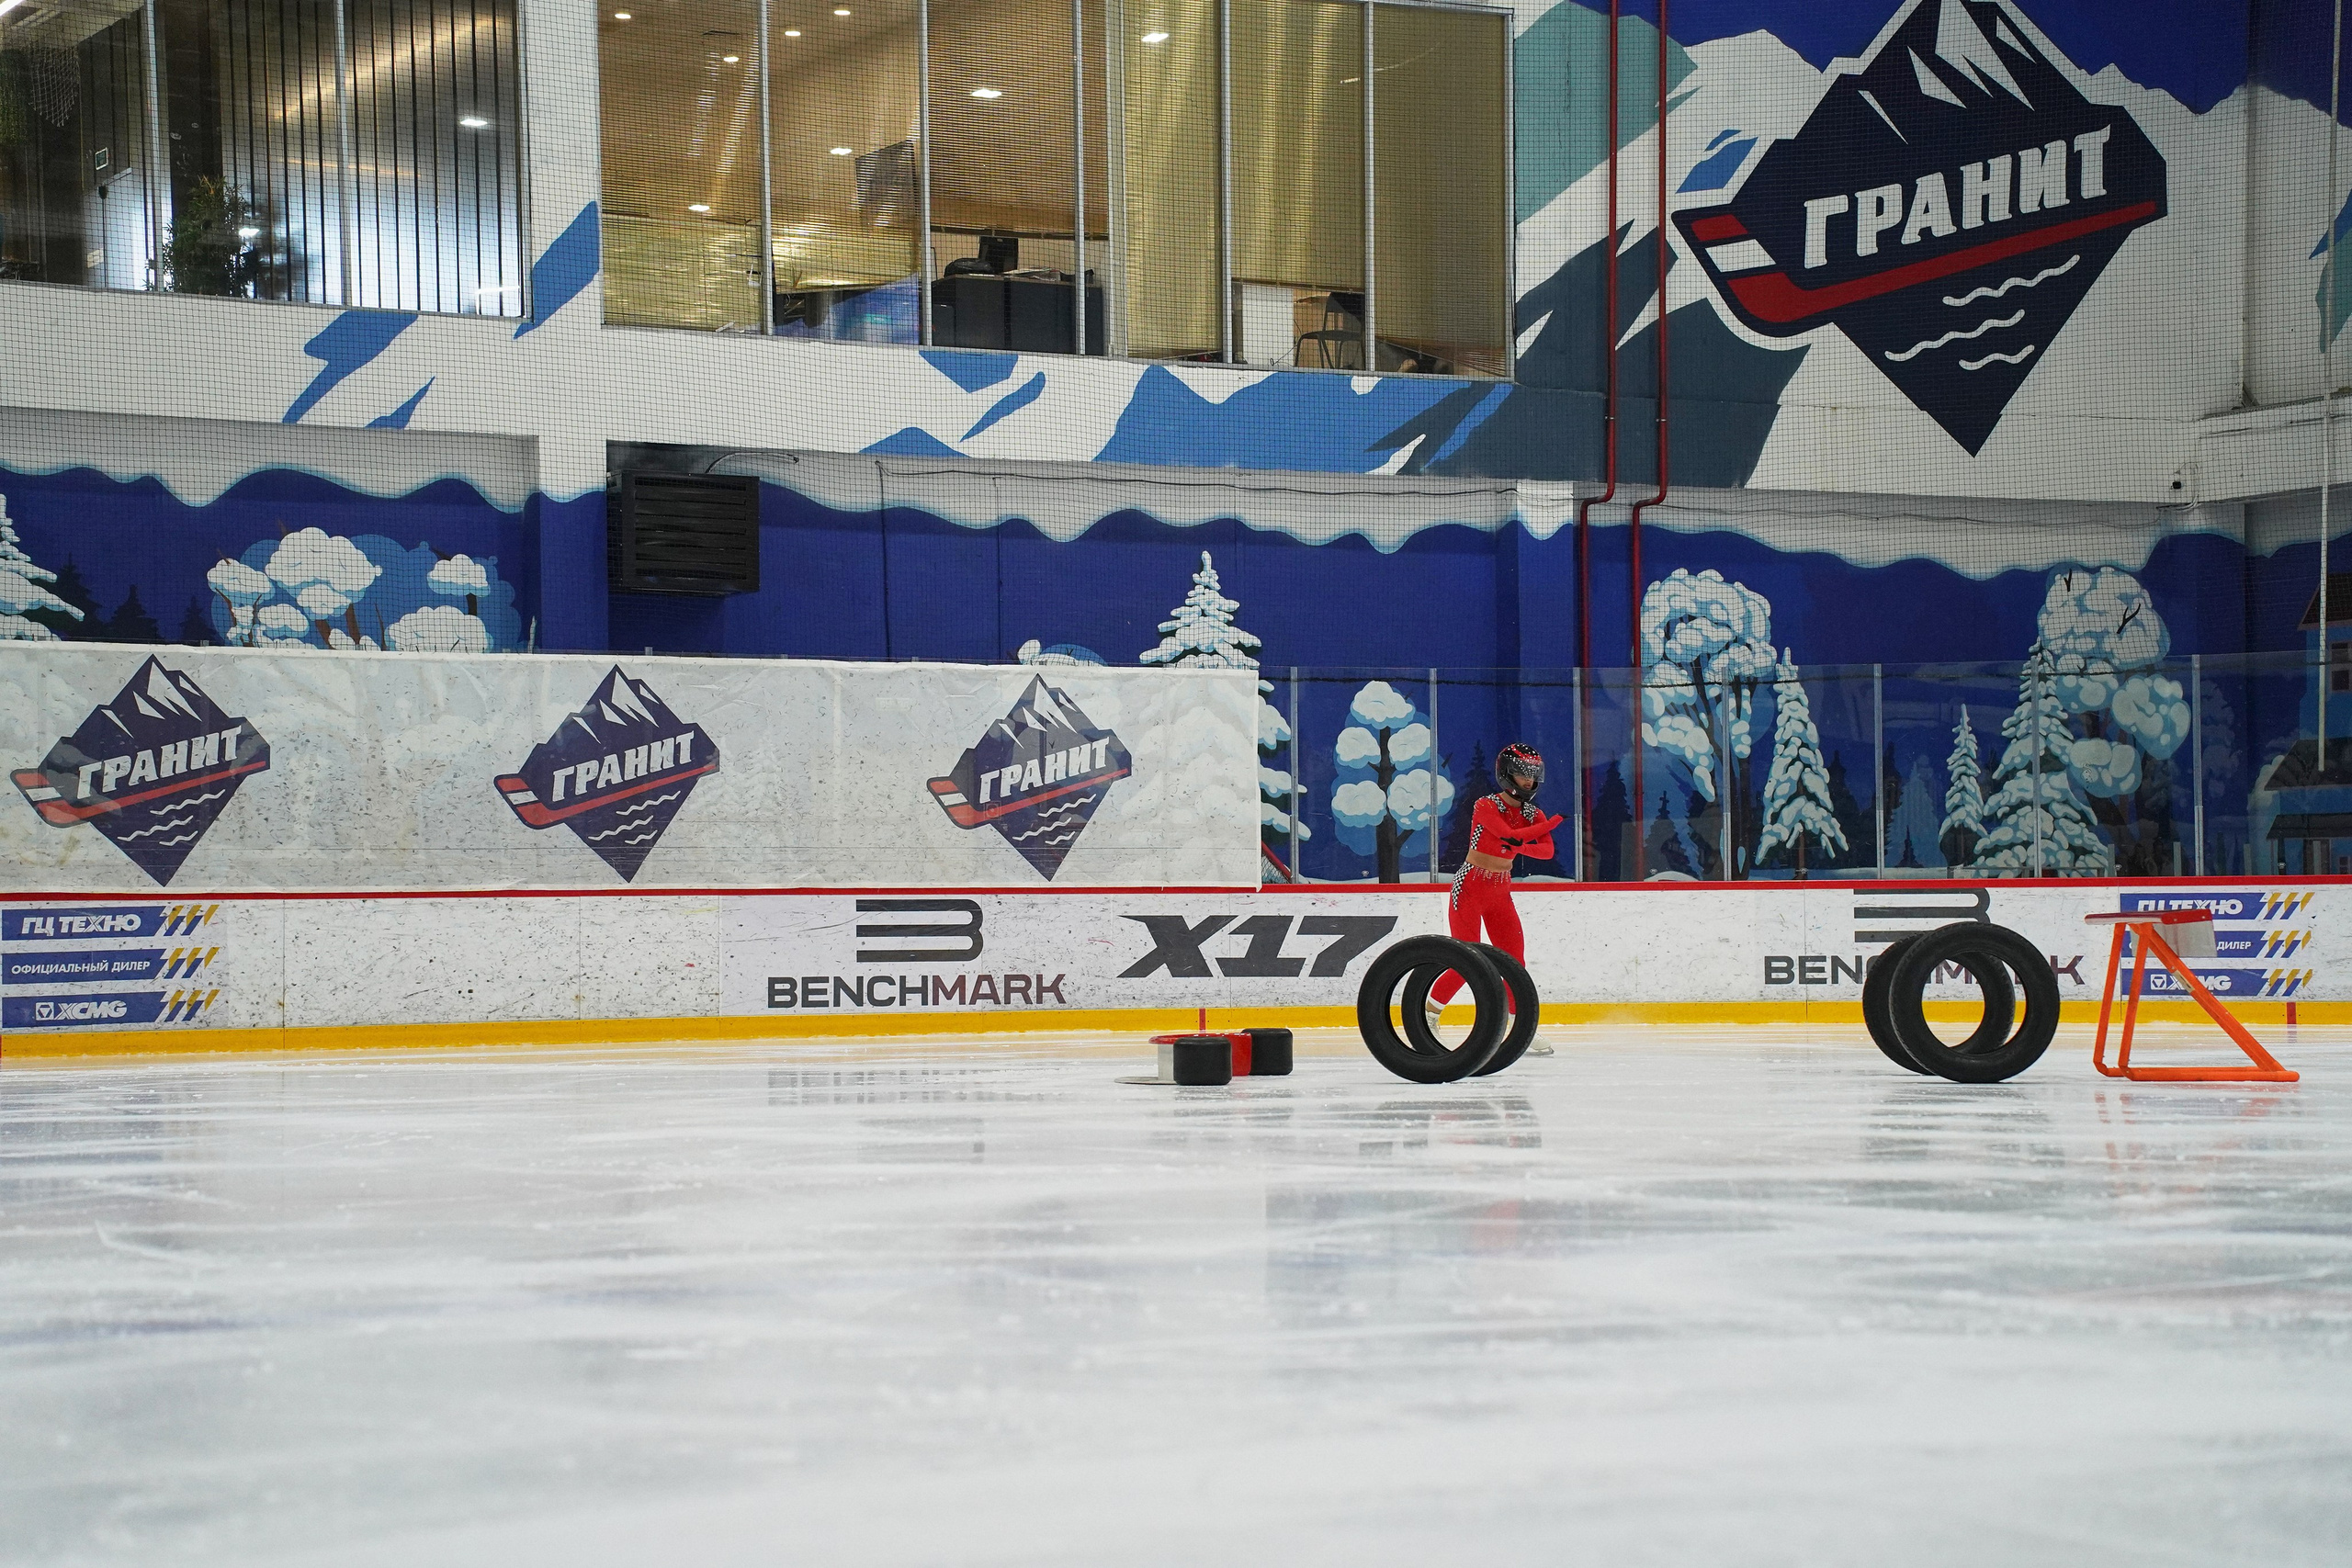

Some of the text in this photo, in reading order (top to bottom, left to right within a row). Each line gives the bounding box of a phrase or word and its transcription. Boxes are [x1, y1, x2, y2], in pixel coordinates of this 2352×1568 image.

[1804, 124, 2111, 270] ГРАНИТ
[77, 725, 243, 799] ГРАНИТ
[551, 730, 695, 804] ГРАНИТ
[979, 737, 1110, 804] ГРАНИТ
[2169, 898, 2244, 915] ТЕХНО
[21, 914, 141, 936] ГЦ ТЕХНО
[1117, 915, 1399, 978] X17
[2216, 941, 2252, 952] ДИЛЕР
[11, 959, 151, 975] ОФИЦИАЛЬНЫЙ ДИЛЕР
[1764, 955, 2086, 985] BENMK
[767, 974, 1068, 1009] BENCHMARK
[2166, 975, 2233, 991] XMG
[54, 1000, 128, 1021] XCMG
